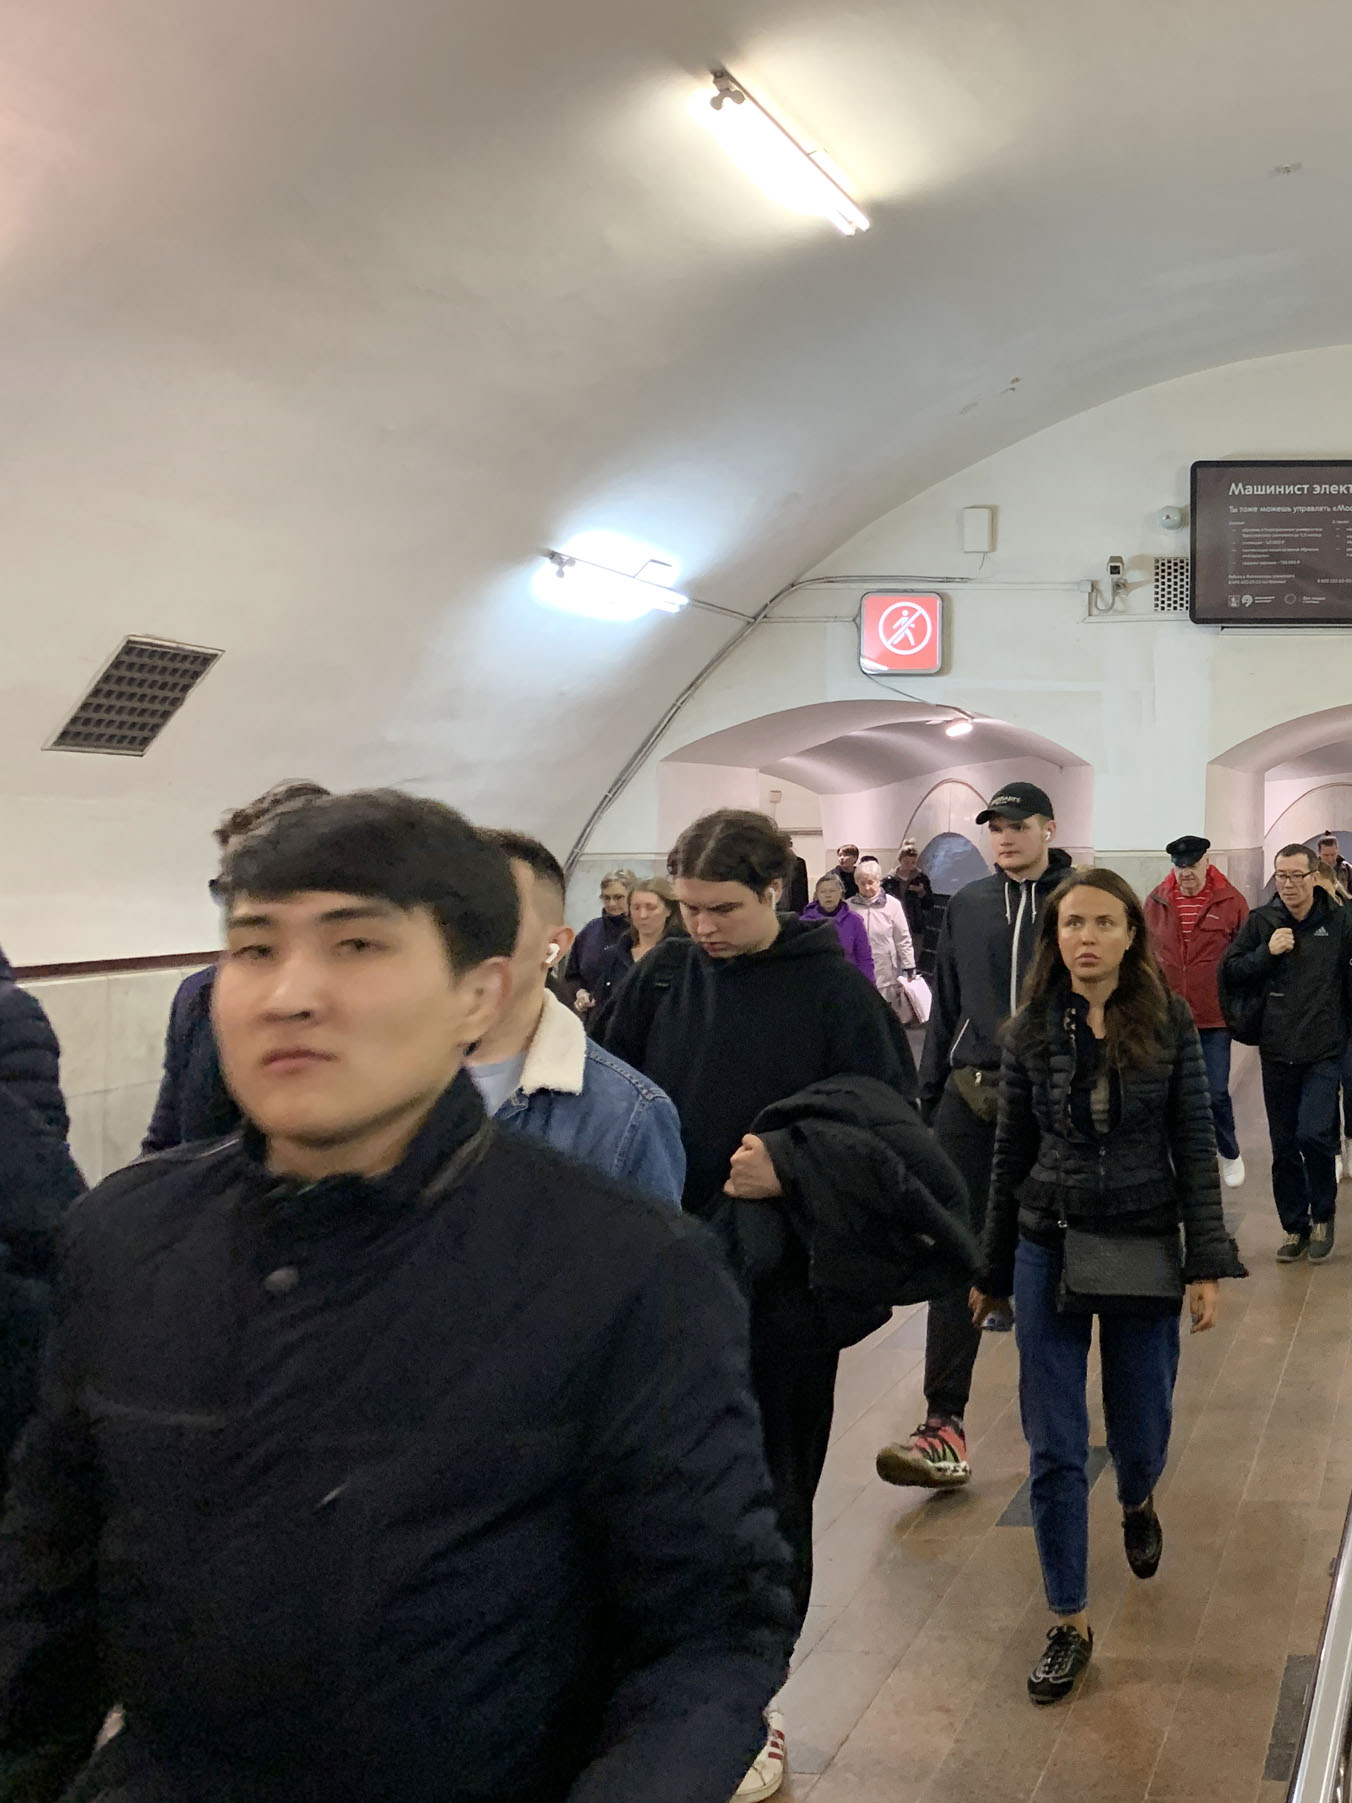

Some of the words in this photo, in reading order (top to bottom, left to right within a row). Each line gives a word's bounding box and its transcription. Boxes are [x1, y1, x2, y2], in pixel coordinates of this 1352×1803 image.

[1228, 482, 1309, 496] Машинист
[1229, 505, 1238, 513] Ты
[1292, 506, 1331, 515] управлять
